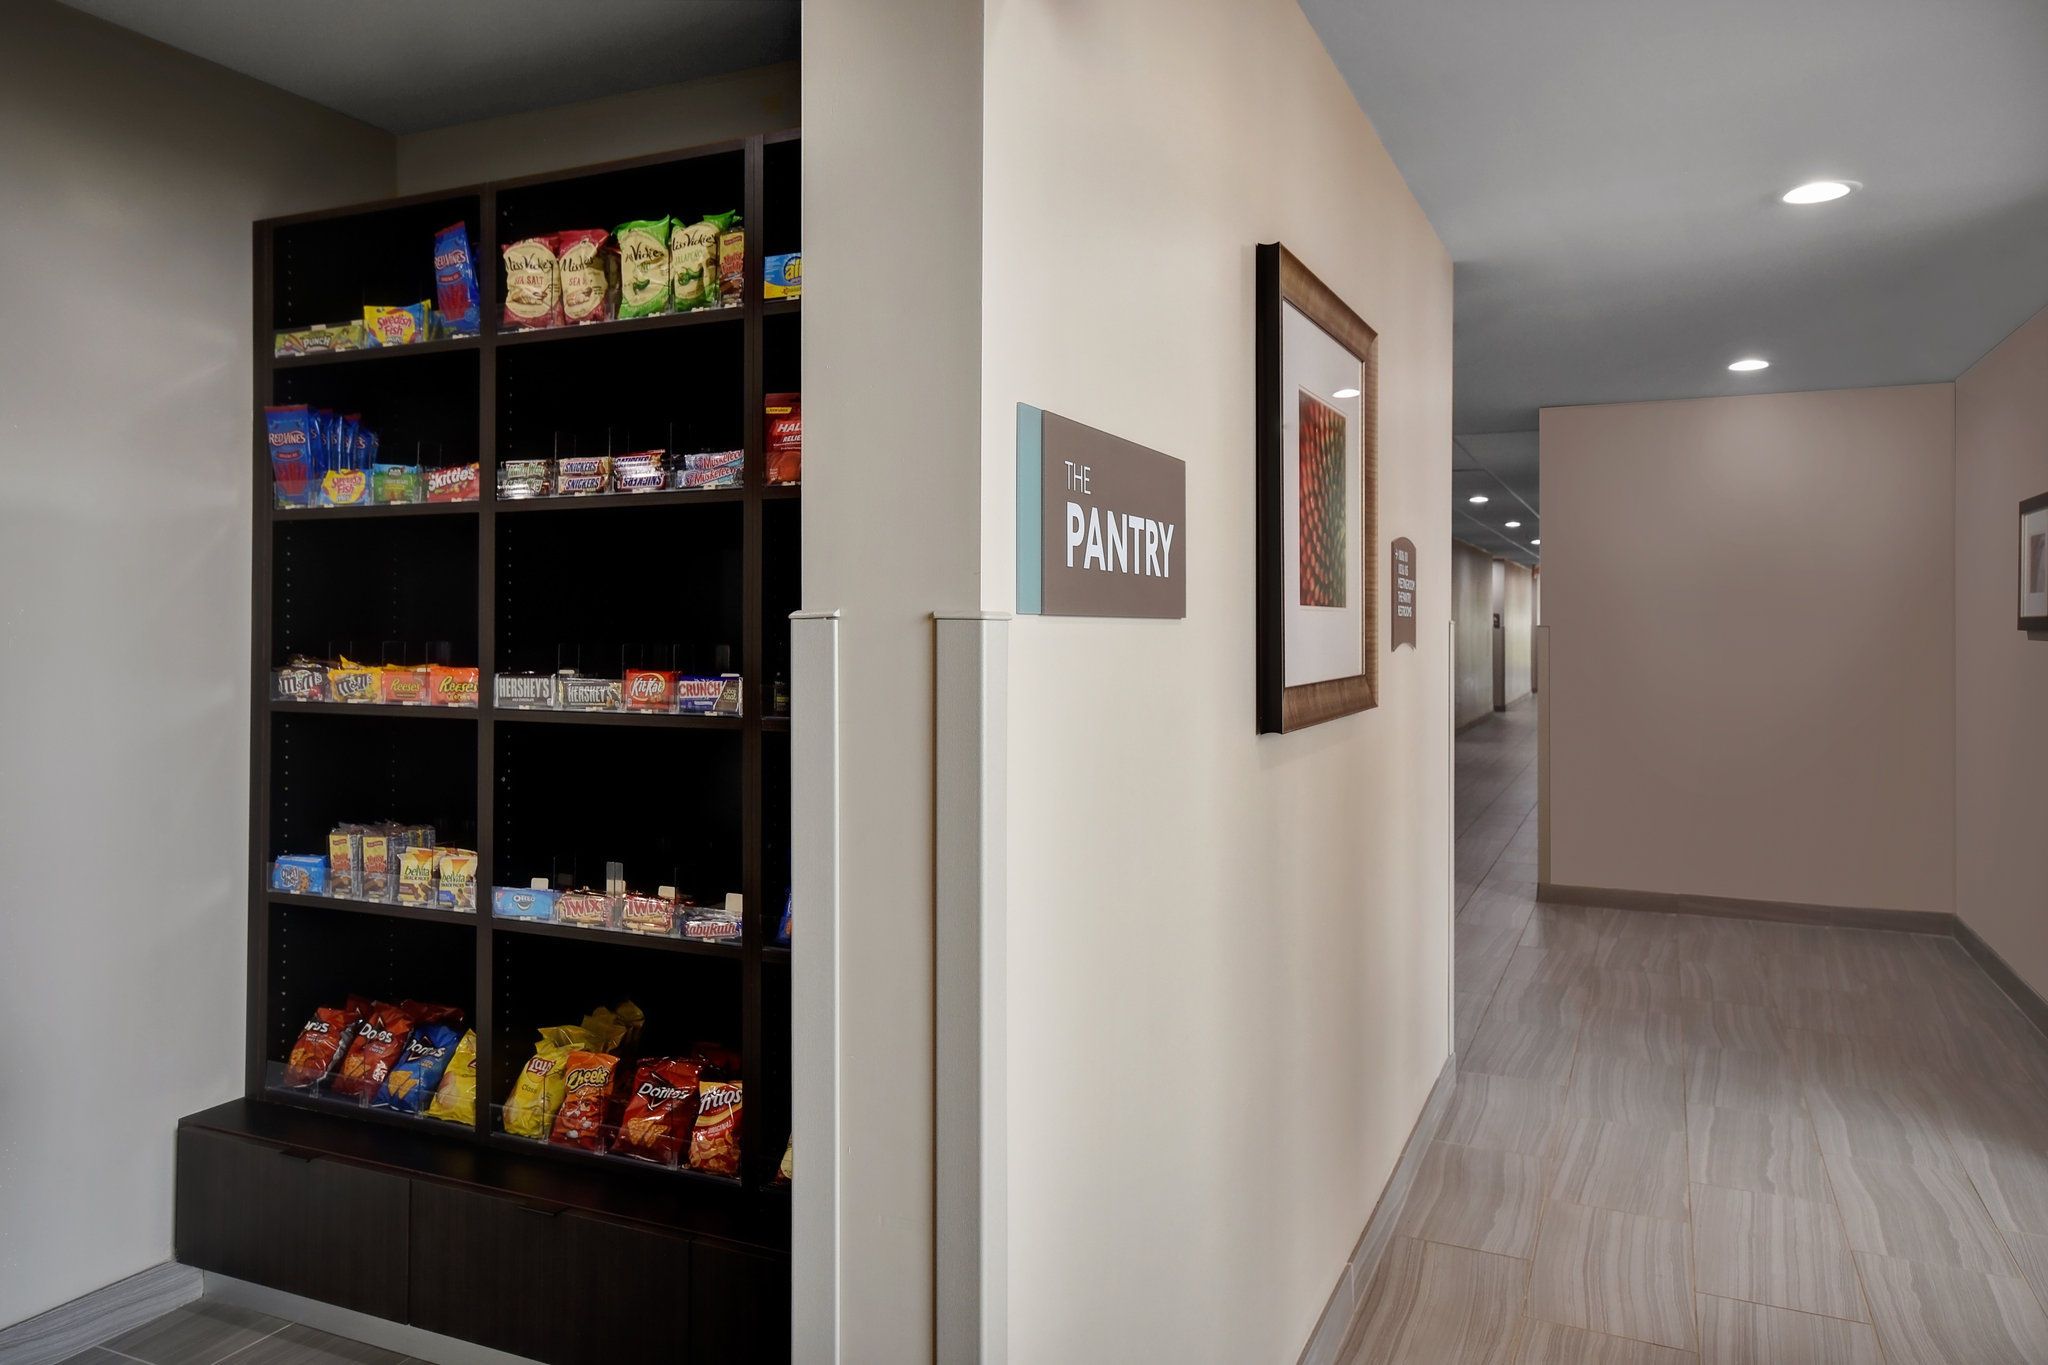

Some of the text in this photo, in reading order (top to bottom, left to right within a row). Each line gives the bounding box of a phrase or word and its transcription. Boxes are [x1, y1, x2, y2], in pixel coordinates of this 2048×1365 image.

[785, 258, 801, 281] al
[527, 275, 545, 285] SALT
[384, 325, 403, 336] Fish
[303, 336, 331, 348] PUNCH
[564, 462, 597, 474] SNICKERS
[428, 468, 475, 491] Skittles
[565, 478, 601, 490] SNICKERS
[1065, 460, 1091, 495] THE
[1066, 501, 1174, 578] PANTRY
[499, 678, 550, 698] HERSHEY'S
[568, 685, 612, 703] HERSHEY'S
[679, 683, 720, 697] CRUNCH
[513, 894, 536, 902] OREO
[563, 894, 600, 917] TWIX
[638, 1082, 690, 1100] Doritos
[698, 1087, 743, 1115] Fritos
